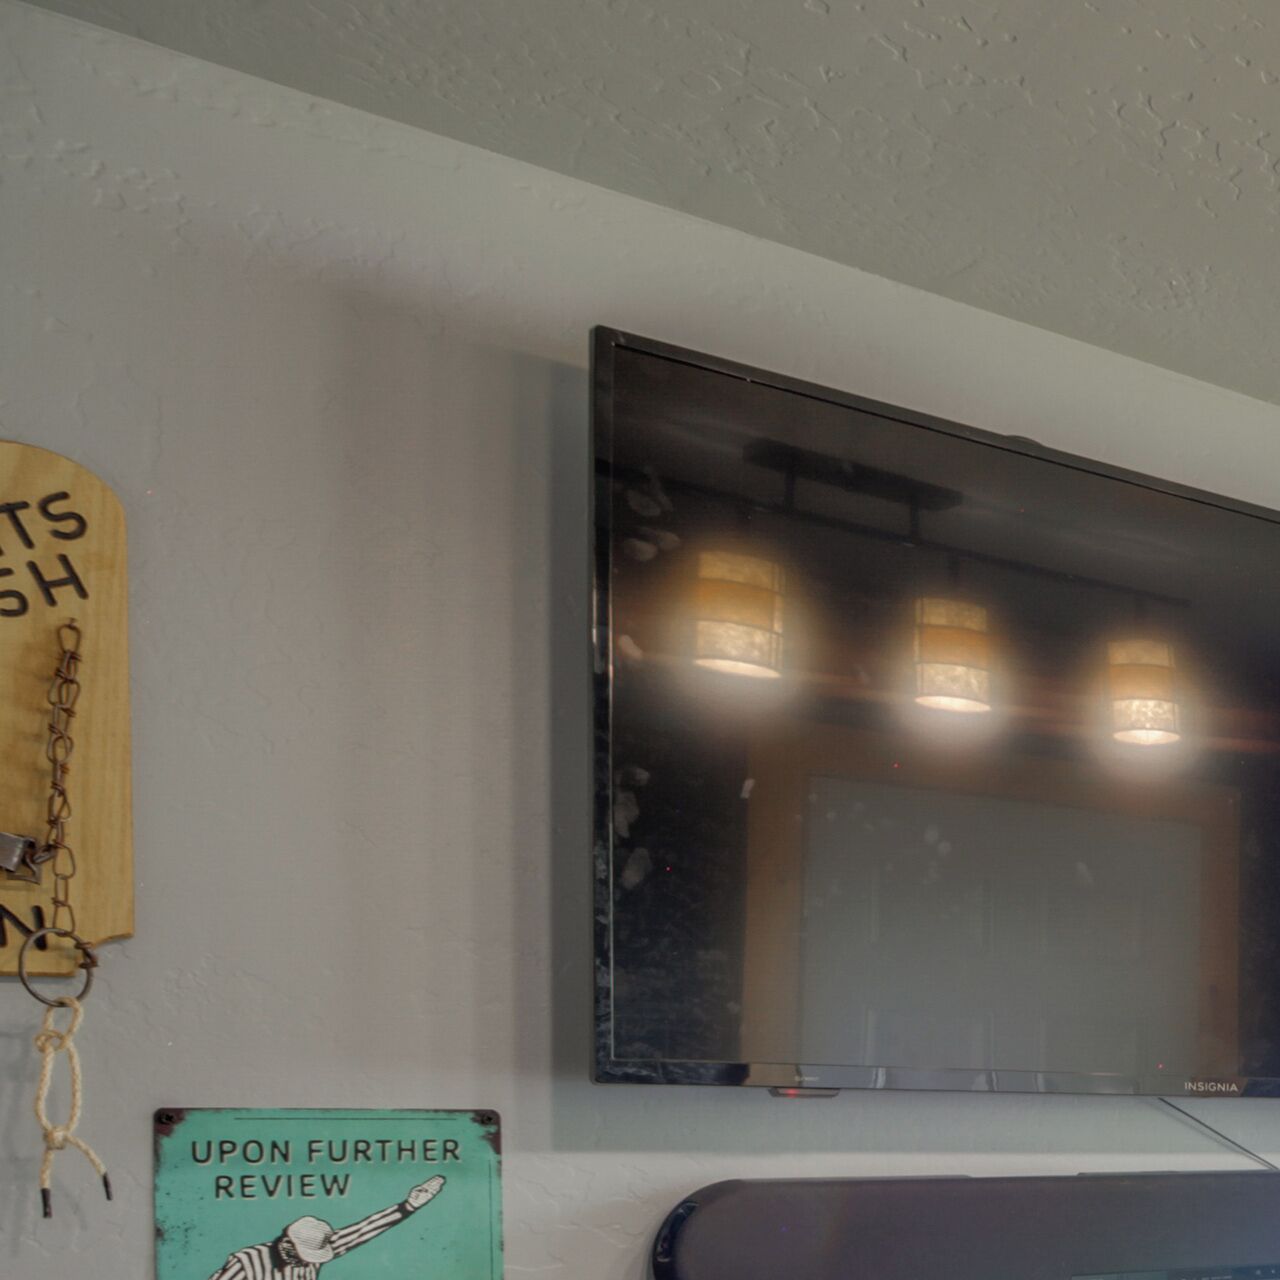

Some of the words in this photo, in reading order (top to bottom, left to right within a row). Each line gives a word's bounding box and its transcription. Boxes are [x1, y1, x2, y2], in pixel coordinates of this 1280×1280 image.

[1184, 1081, 1240, 1092] INSIGNIA
[192, 1140, 291, 1165] UPON
[307, 1139, 461, 1164] FURTHER
[215, 1174, 351, 1199] REVIEW
